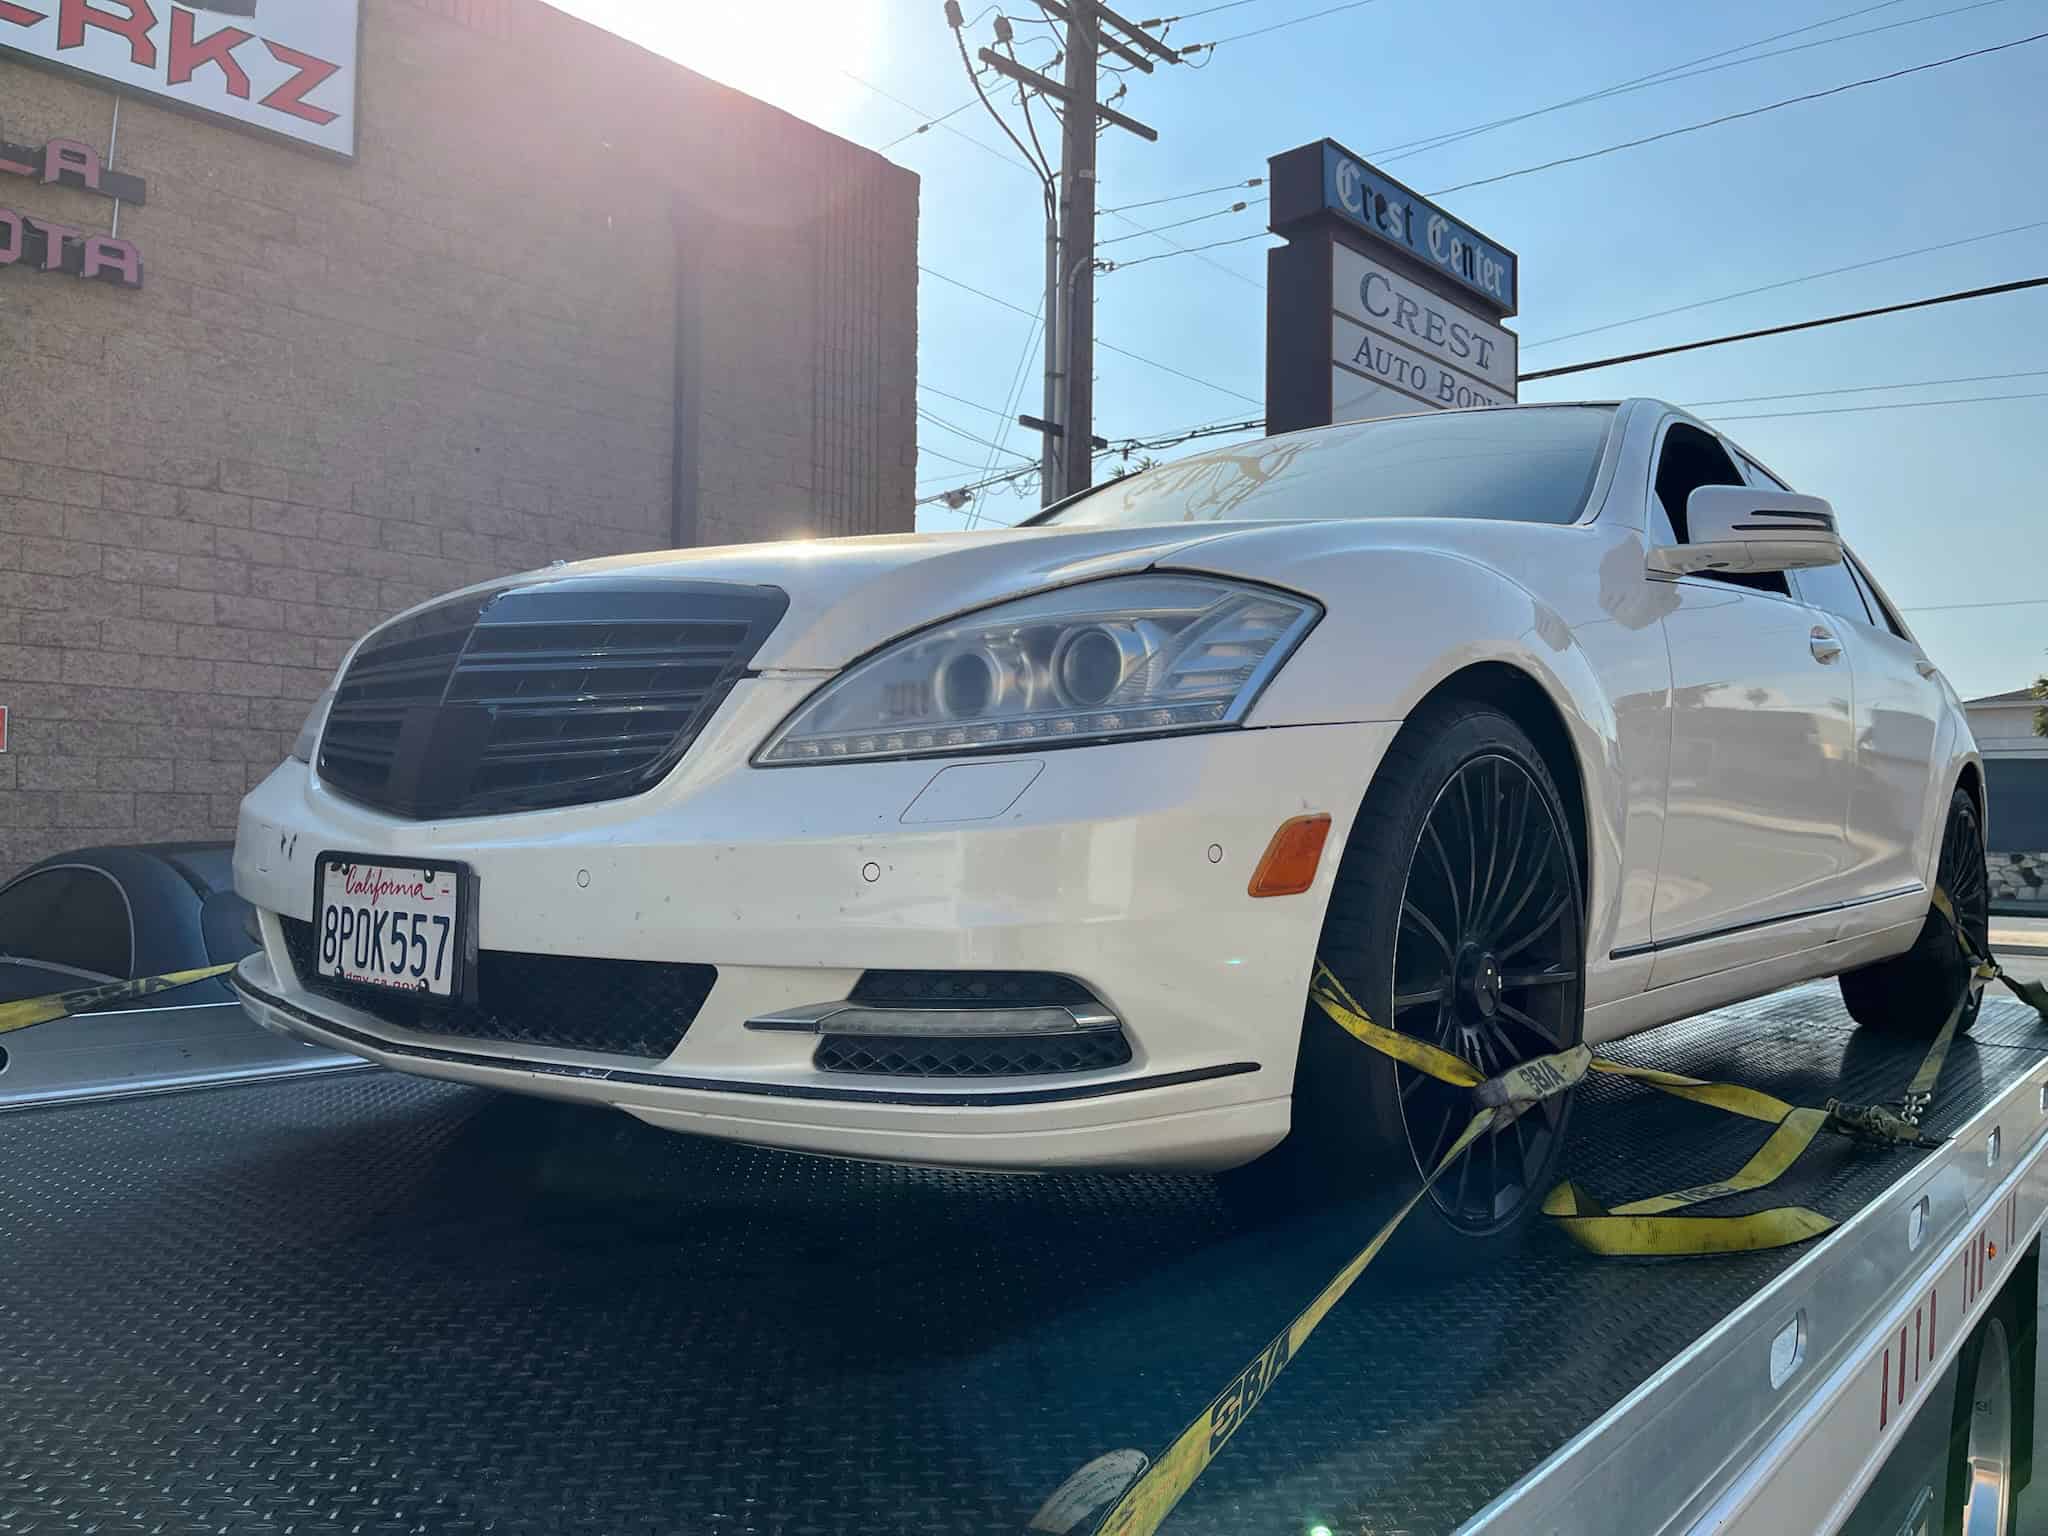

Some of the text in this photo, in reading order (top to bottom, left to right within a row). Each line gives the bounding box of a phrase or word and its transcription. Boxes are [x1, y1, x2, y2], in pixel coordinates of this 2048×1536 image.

[0, 0, 342, 126] RKZ
[1335, 158, 1505, 297] Crest Center
[1359, 272, 1495, 371] CREST
[1352, 336, 1500, 408] AUTO BOD
[346, 864, 434, 906] California
